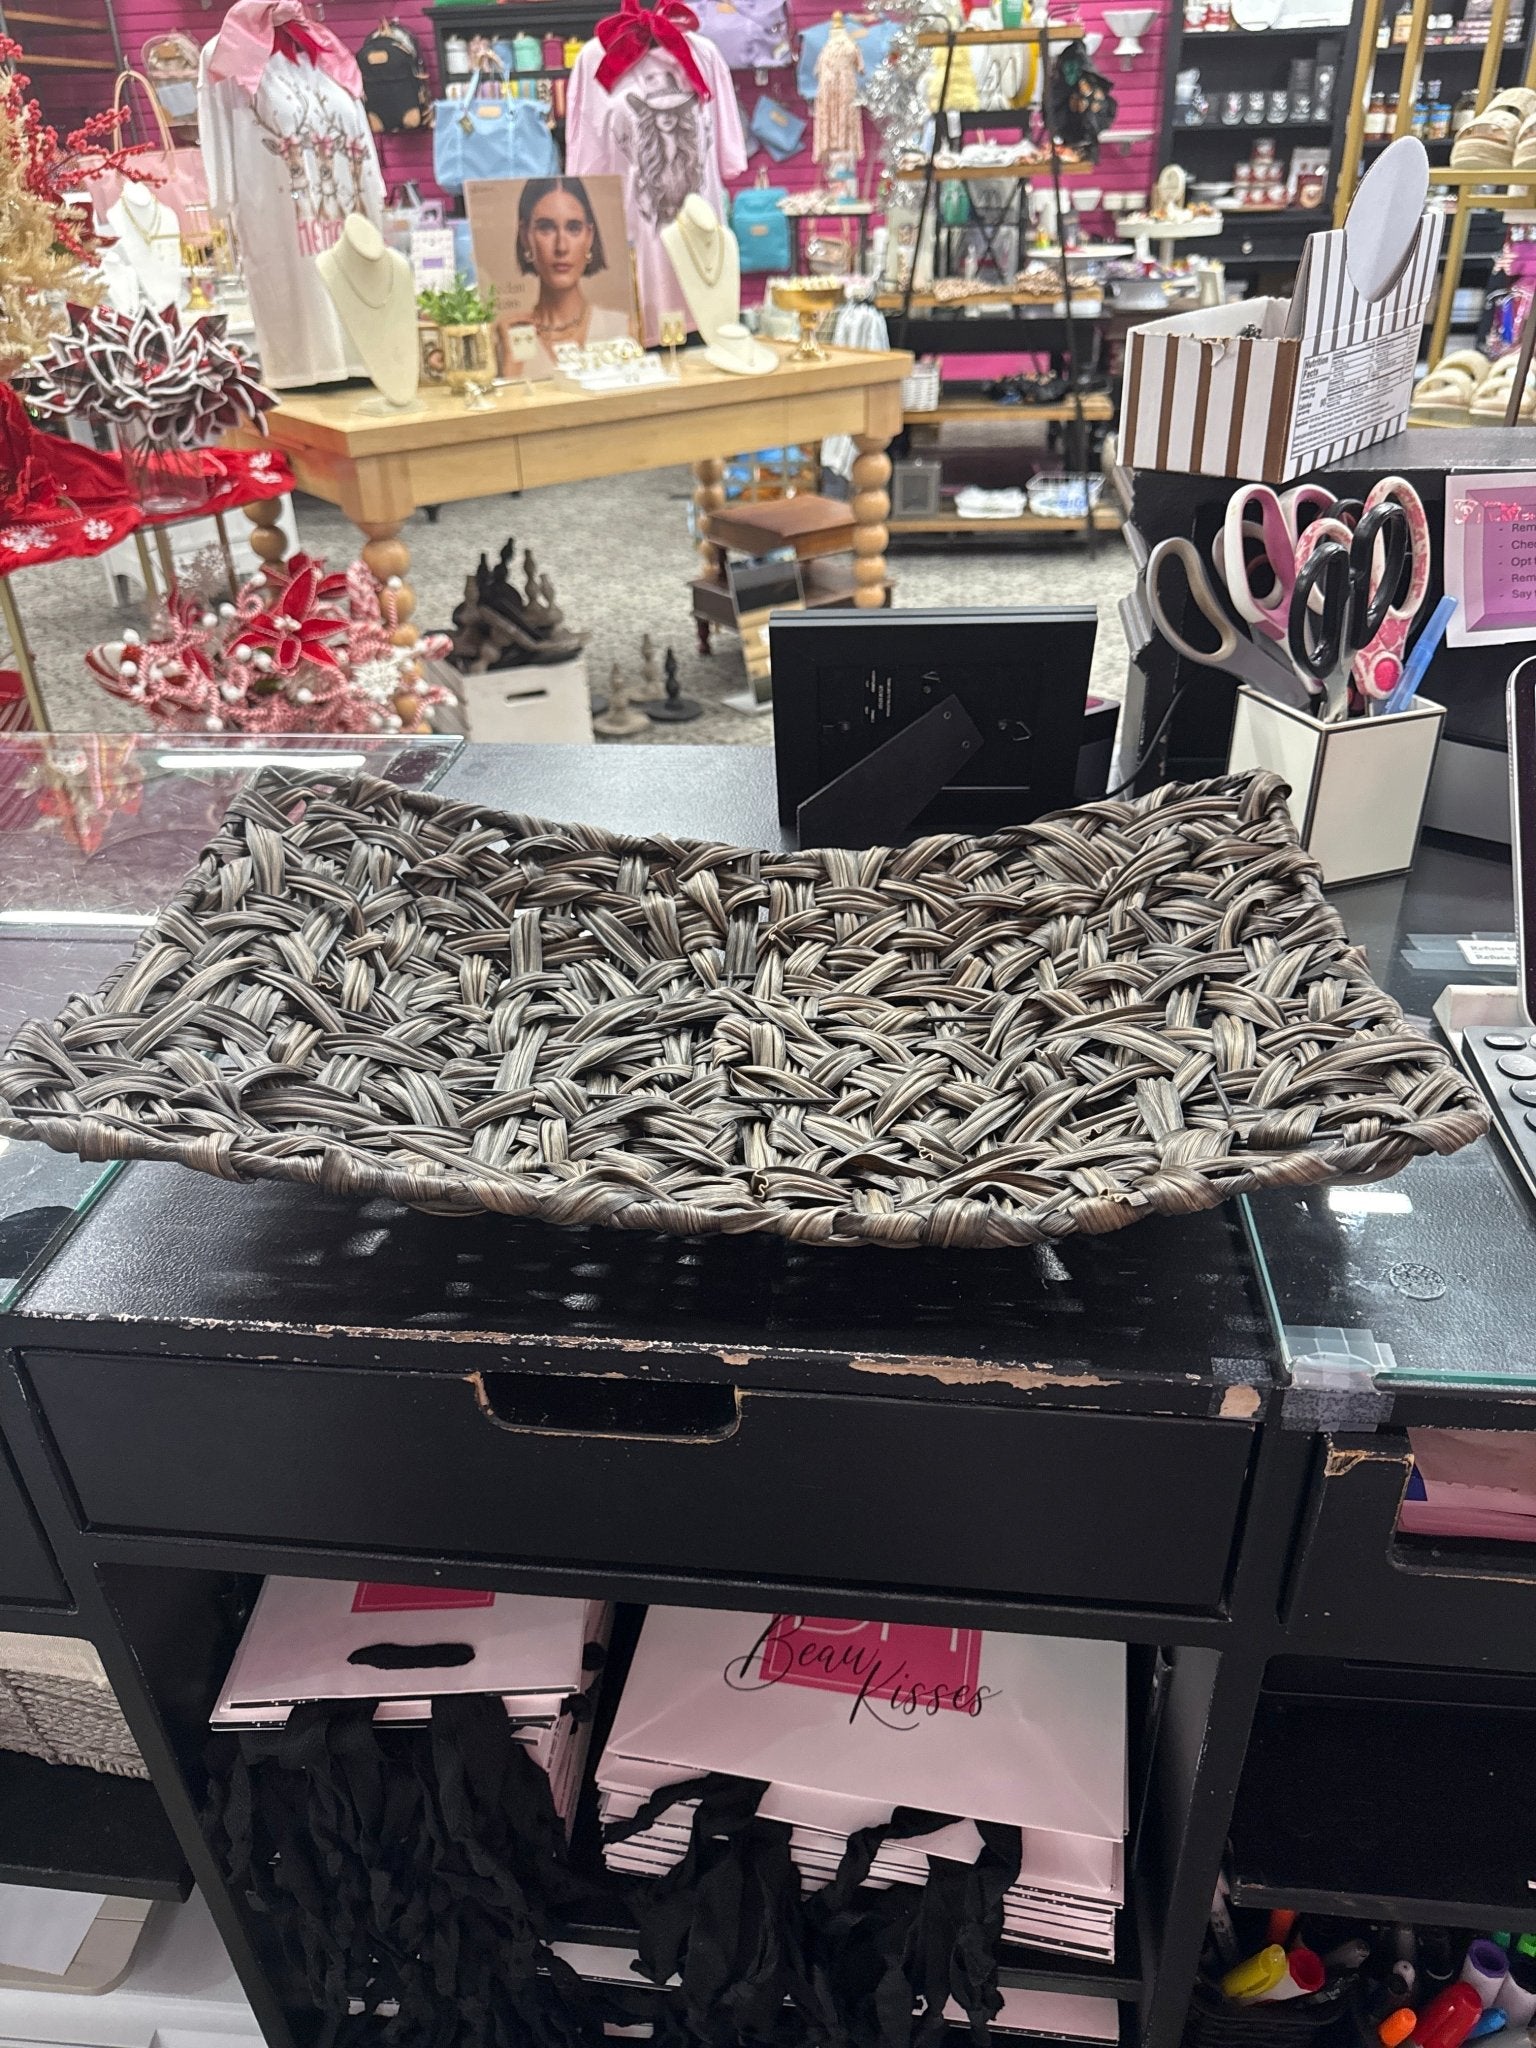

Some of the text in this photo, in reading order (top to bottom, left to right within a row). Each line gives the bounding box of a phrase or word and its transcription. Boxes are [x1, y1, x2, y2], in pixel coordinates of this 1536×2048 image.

[1305, 356, 1328, 368] Nutrition
[1303, 368, 1319, 379] Facts
[1511, 557, 1532, 568] Opt
[1511, 589, 1532, 600] Say
[724, 1613, 879, 1691] Beau
[850, 1660, 1003, 1731] Kisses
